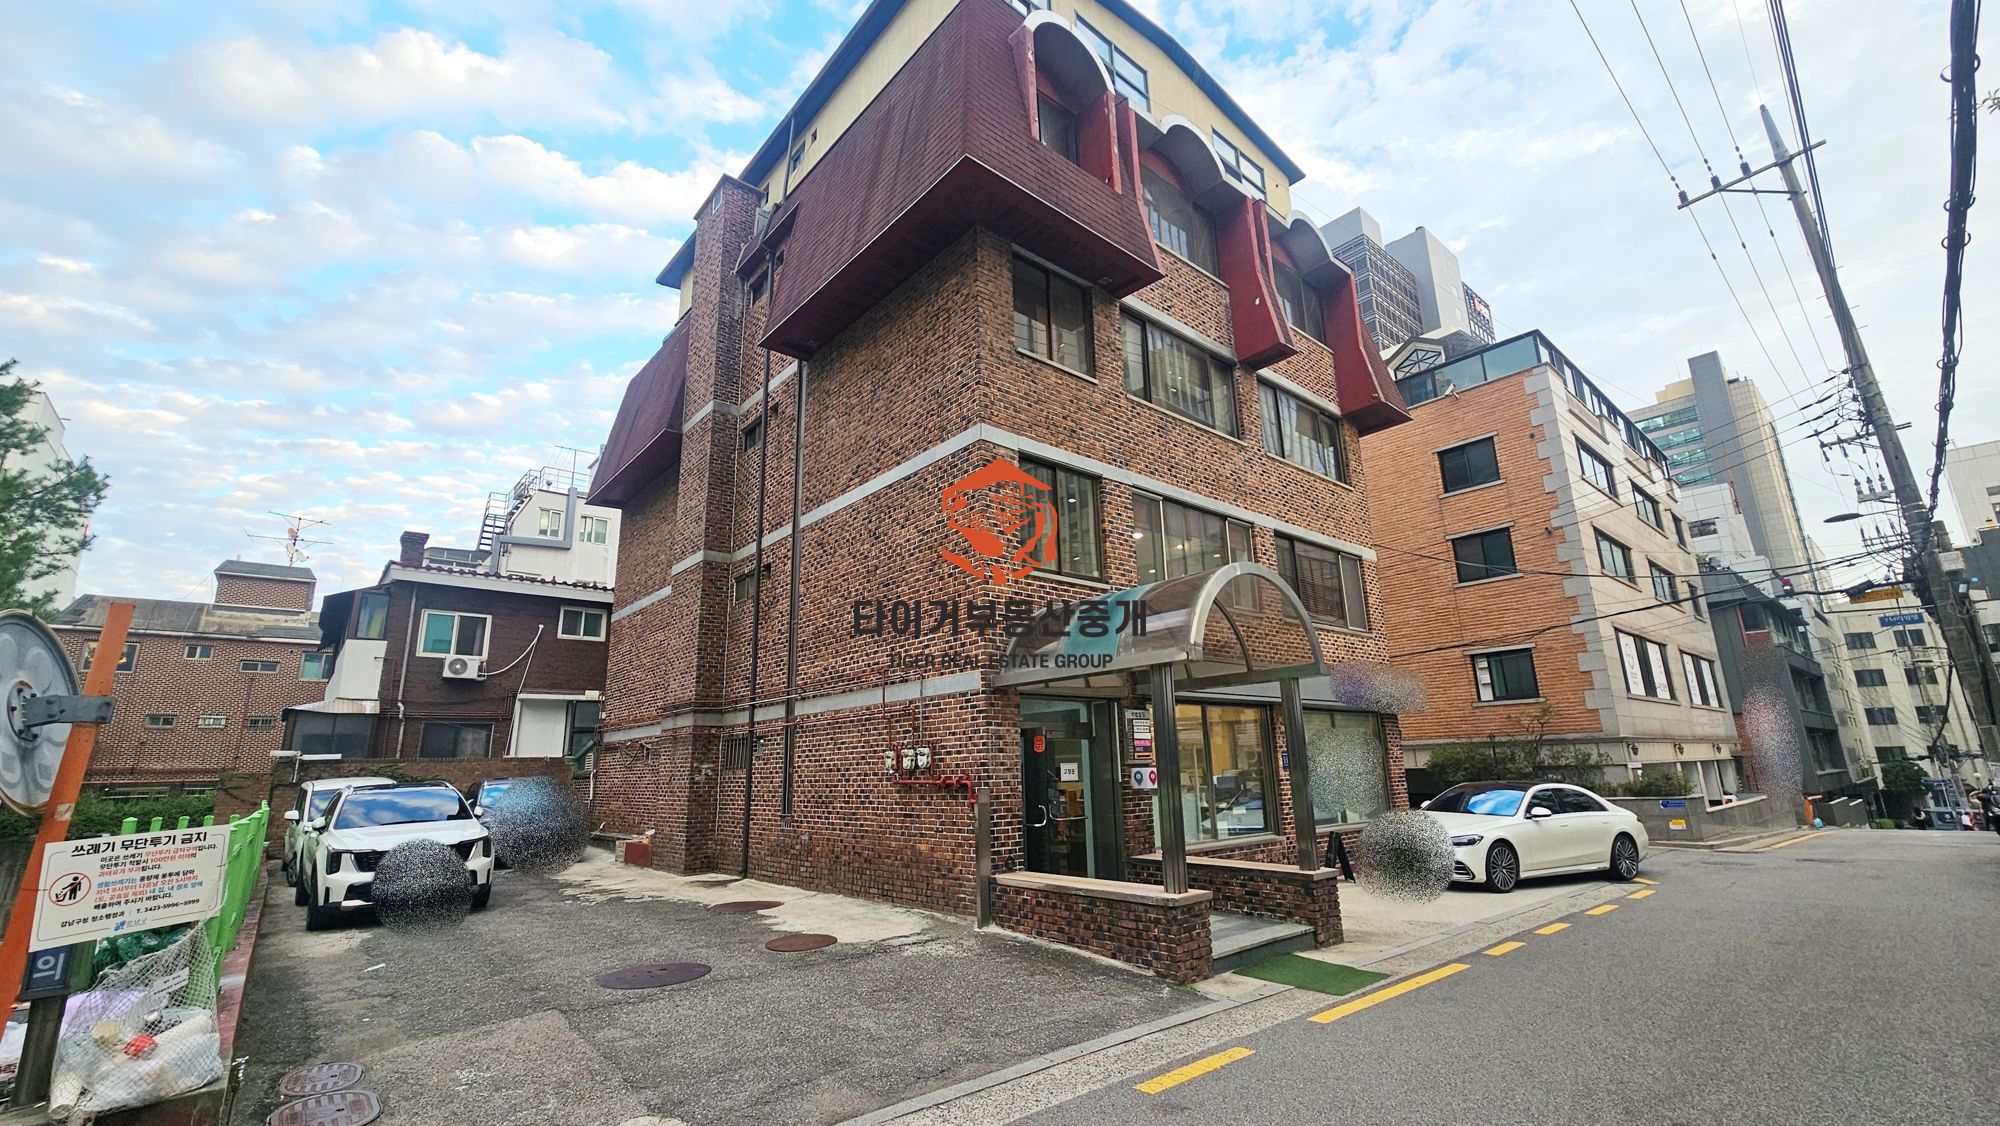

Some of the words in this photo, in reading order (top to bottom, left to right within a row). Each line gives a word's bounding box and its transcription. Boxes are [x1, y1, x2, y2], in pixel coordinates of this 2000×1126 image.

[71, 841, 116, 858] 쓰레기
[120, 834, 177, 851] 무단투기
[180, 831, 208, 845] 금지
[100, 854, 120, 863] 이곳은
[122, 852, 142, 860] 쓰레기
[99, 860, 126, 870] 무단투기
[128, 858, 148, 866] 적발시
[123, 896, 143, 905] 주시기
[60, 916, 88, 927] 강남구청
